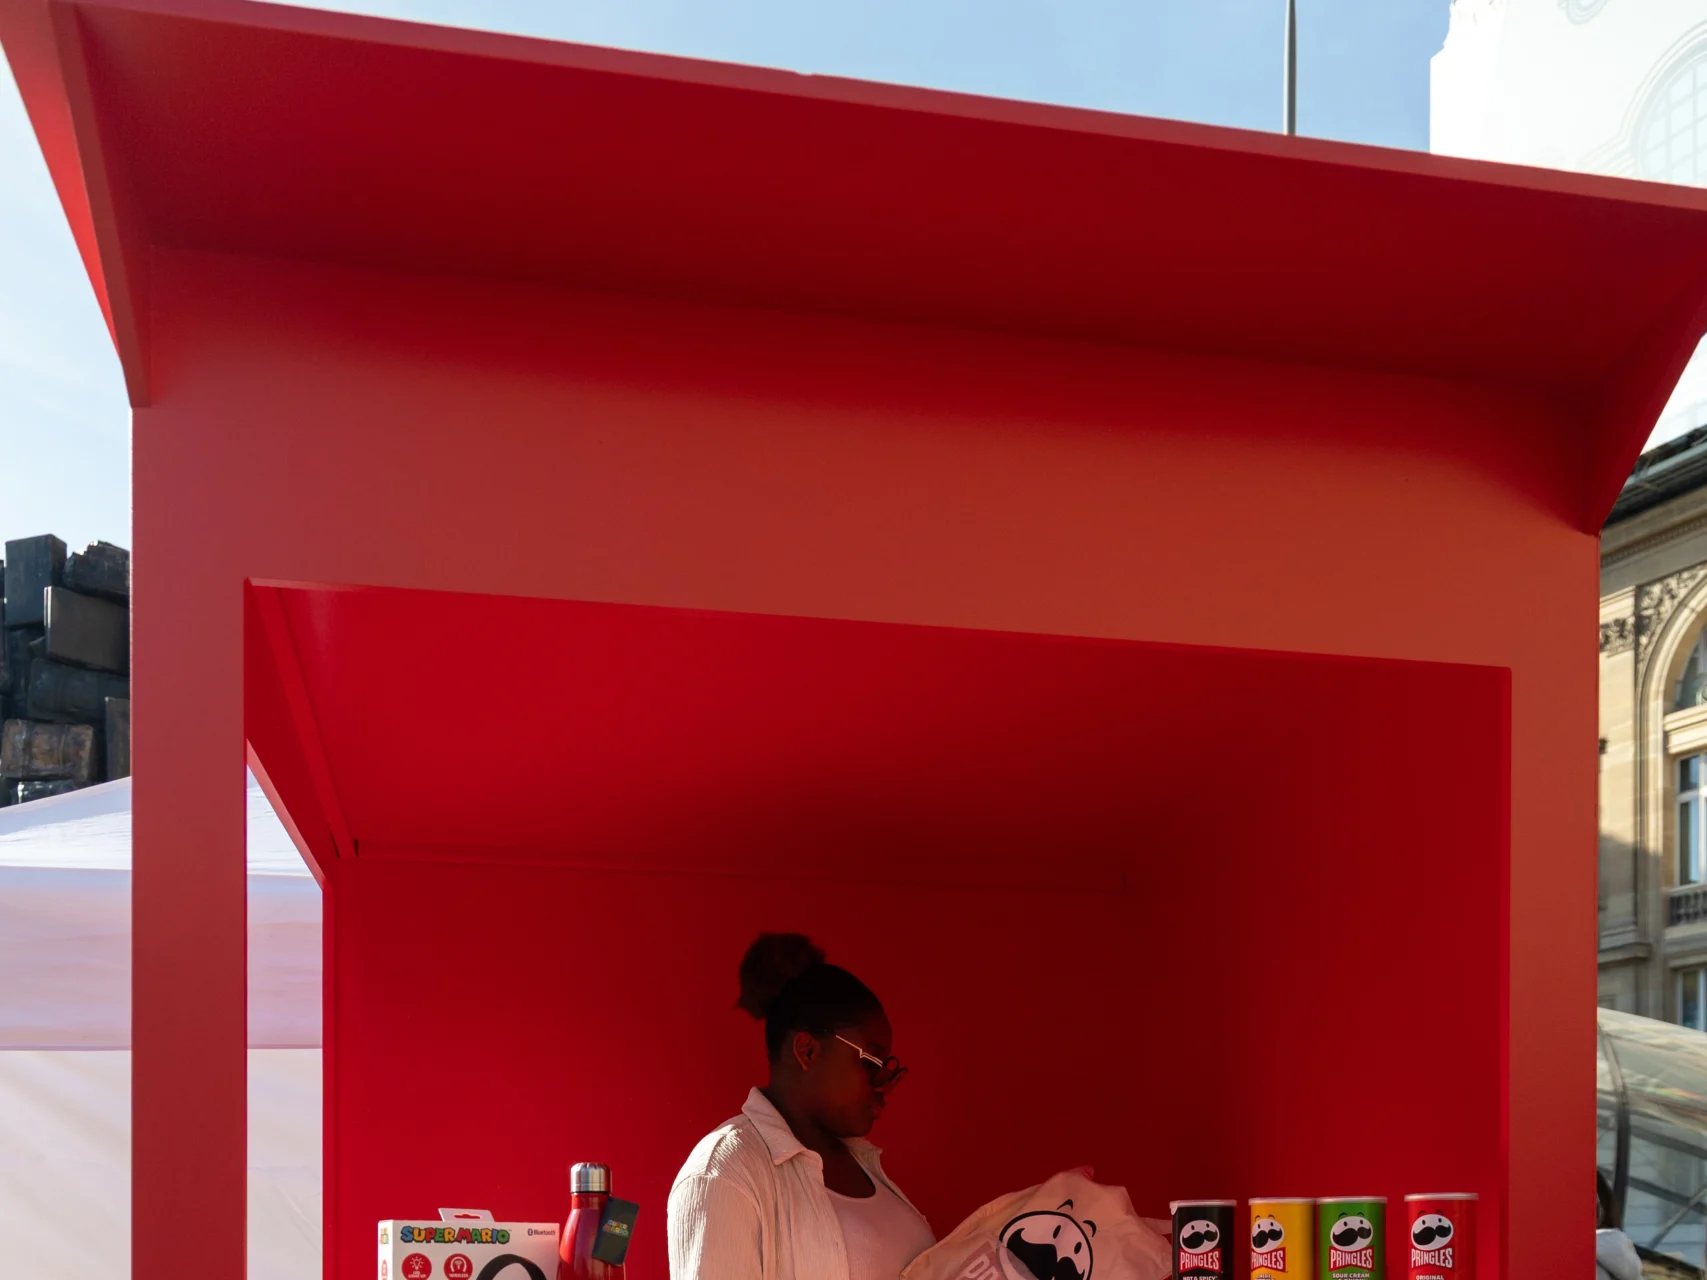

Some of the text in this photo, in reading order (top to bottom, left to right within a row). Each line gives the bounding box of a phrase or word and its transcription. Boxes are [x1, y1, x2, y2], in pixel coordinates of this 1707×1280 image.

[400, 1225, 456, 1243] SUPER
[455, 1227, 510, 1245] MARIO
[534, 1228, 556, 1236] Bluetooth
[1180, 1251, 1219, 1271] PRINGLES
[1330, 1248, 1373, 1269] PRINGLES
[1411, 1248, 1453, 1269] PRINGLES
